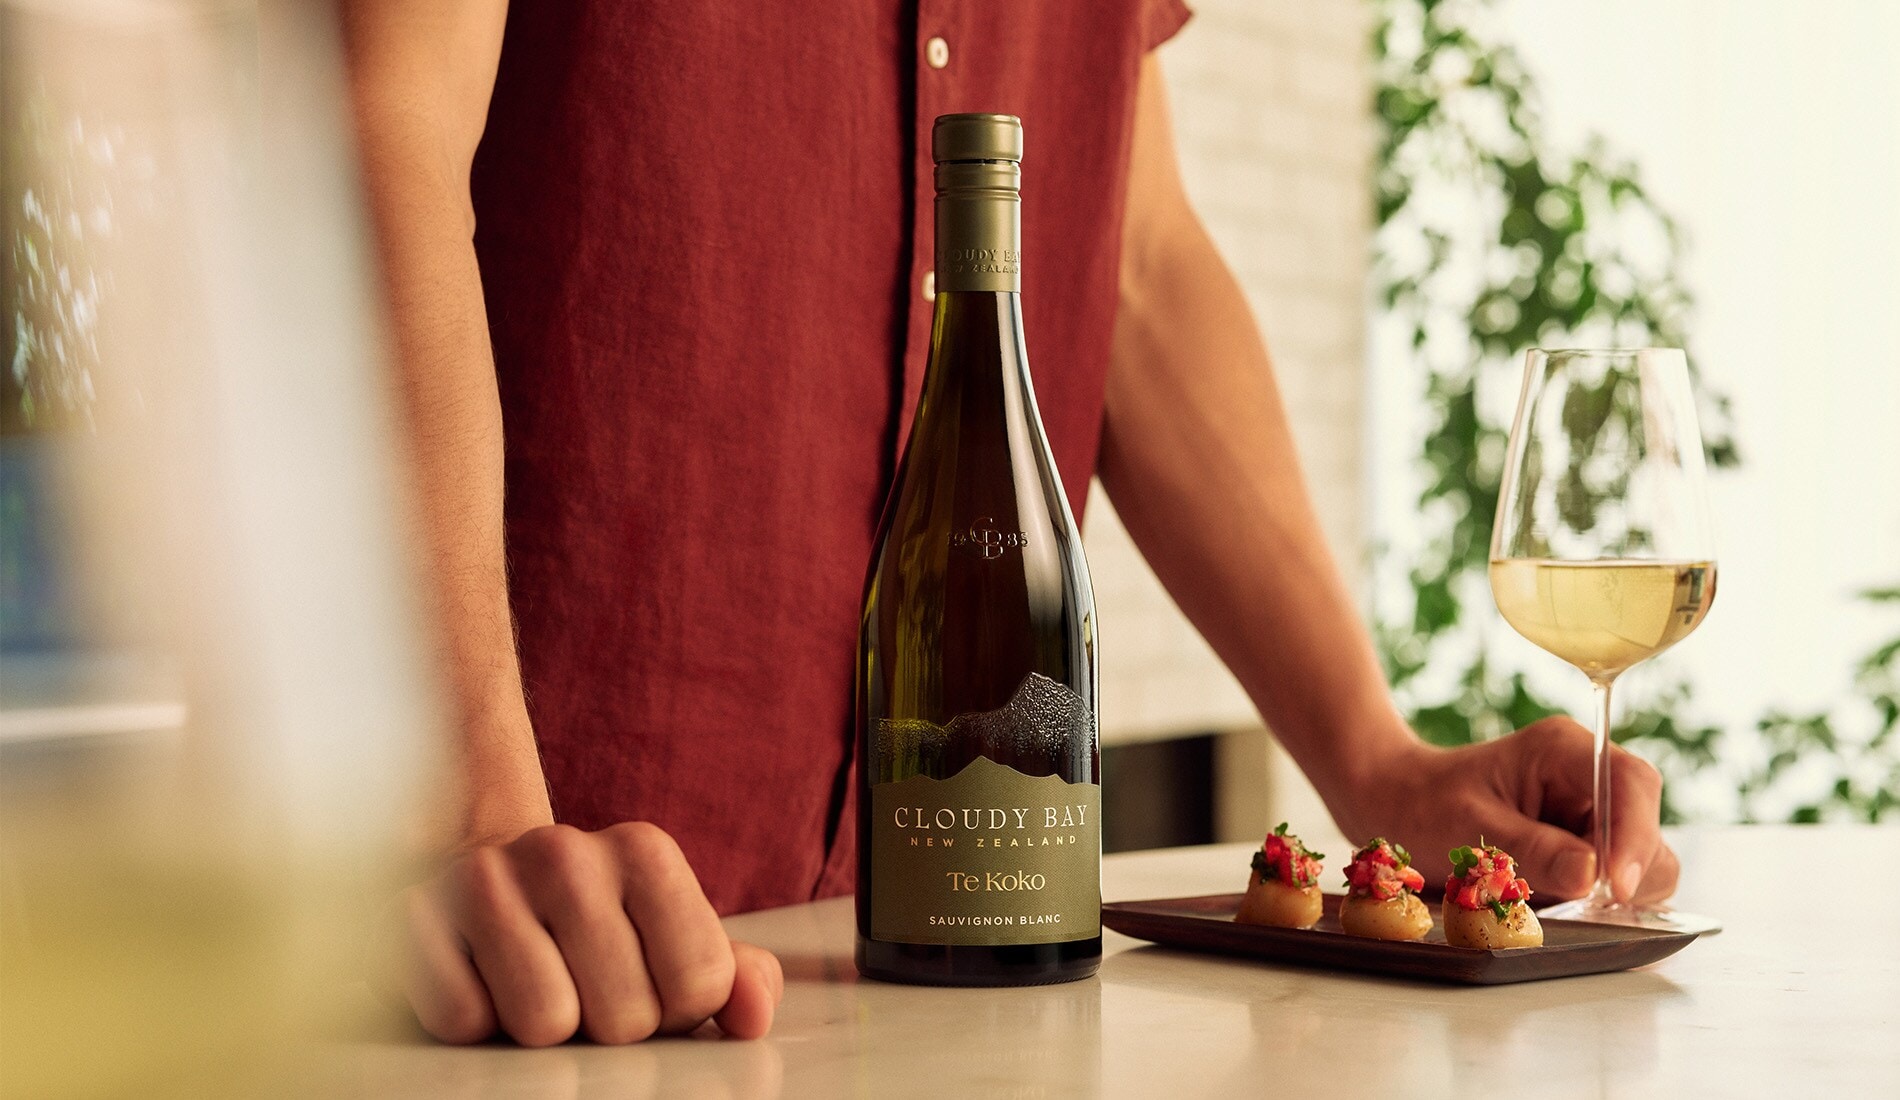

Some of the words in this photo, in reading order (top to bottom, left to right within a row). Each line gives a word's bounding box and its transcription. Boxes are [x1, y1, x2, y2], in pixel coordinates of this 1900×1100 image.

[894, 806, 1029, 830] CLOUDY
[1044, 804, 1088, 829] BAY
[910, 836, 955, 848] NEW
[976, 835, 1077, 848] ZEALAND
[946, 872, 980, 892] Te
[985, 870, 1046, 892] Koko
[929, 915, 1013, 926] SAUVIGNON
[1019, 914, 1061, 925] BLANC
